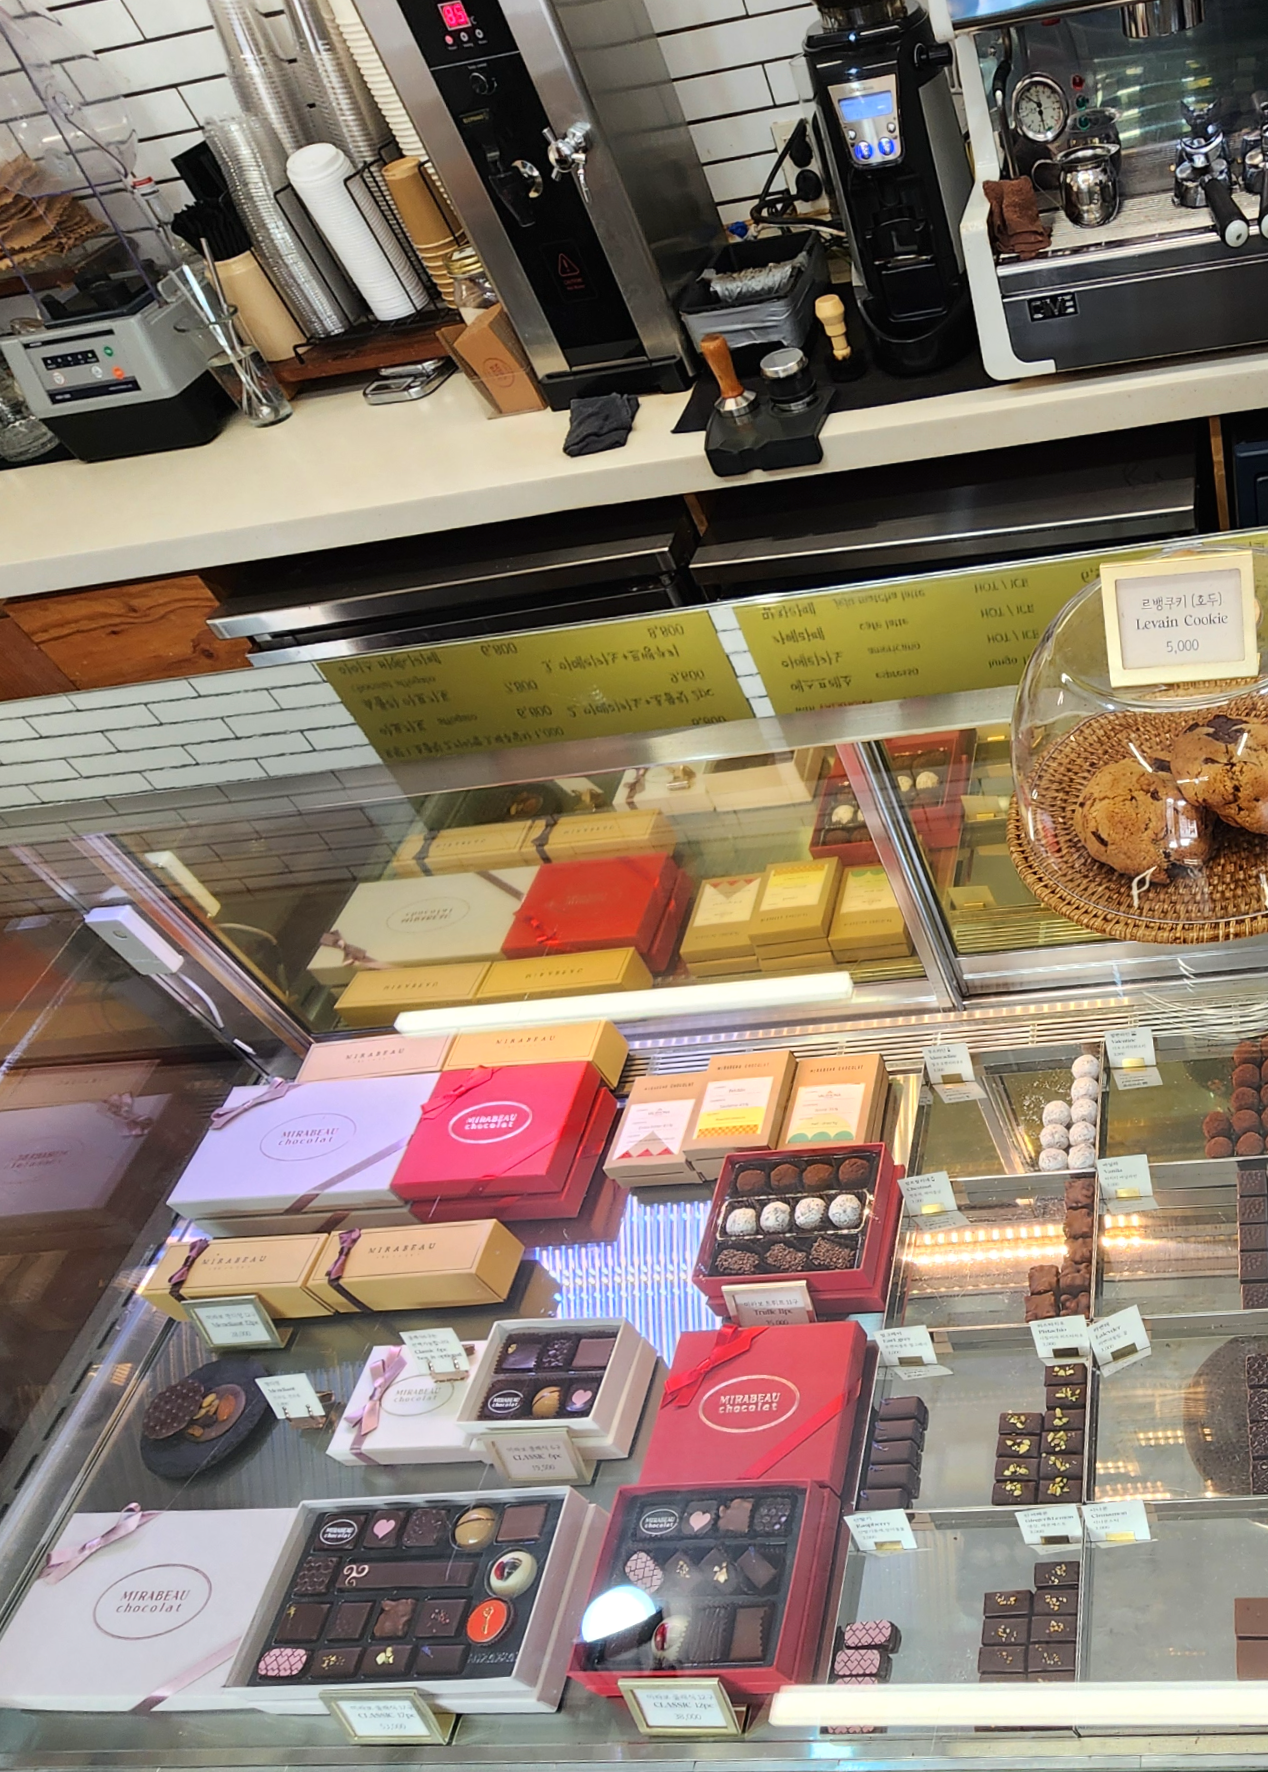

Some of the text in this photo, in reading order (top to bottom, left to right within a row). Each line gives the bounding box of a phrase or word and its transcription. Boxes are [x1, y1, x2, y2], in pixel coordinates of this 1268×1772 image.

[443, 3, 469, 27] 85
[1141, 592, 1222, 611] 르뱅쿠키 (호두)
[1136, 613, 1228, 630] Levain Cookie
[1166, 639, 1199, 654] 5,000
[496, 1035, 556, 1045] MIRABEAU
[345, 1048, 405, 1060] MIRABEAU
[466, 1112, 518, 1125] MIRABEAU
[464, 1120, 514, 1131] chocolat
[278, 1135, 334, 1146] chocolat
[281, 1127, 339, 1141] MIRABEAU
[368, 1242, 437, 1255] MIRABEAU
[396, 1387, 441, 1396] MIRABEAU
[394, 1395, 437, 1403] chocolat
[719, 1392, 781, 1405] MIRABEAU
[718, 1402, 778, 1414] chocolat
[119, 1589, 190, 1603] MIRABEAU
[116, 1600, 182, 1613] chocolat
